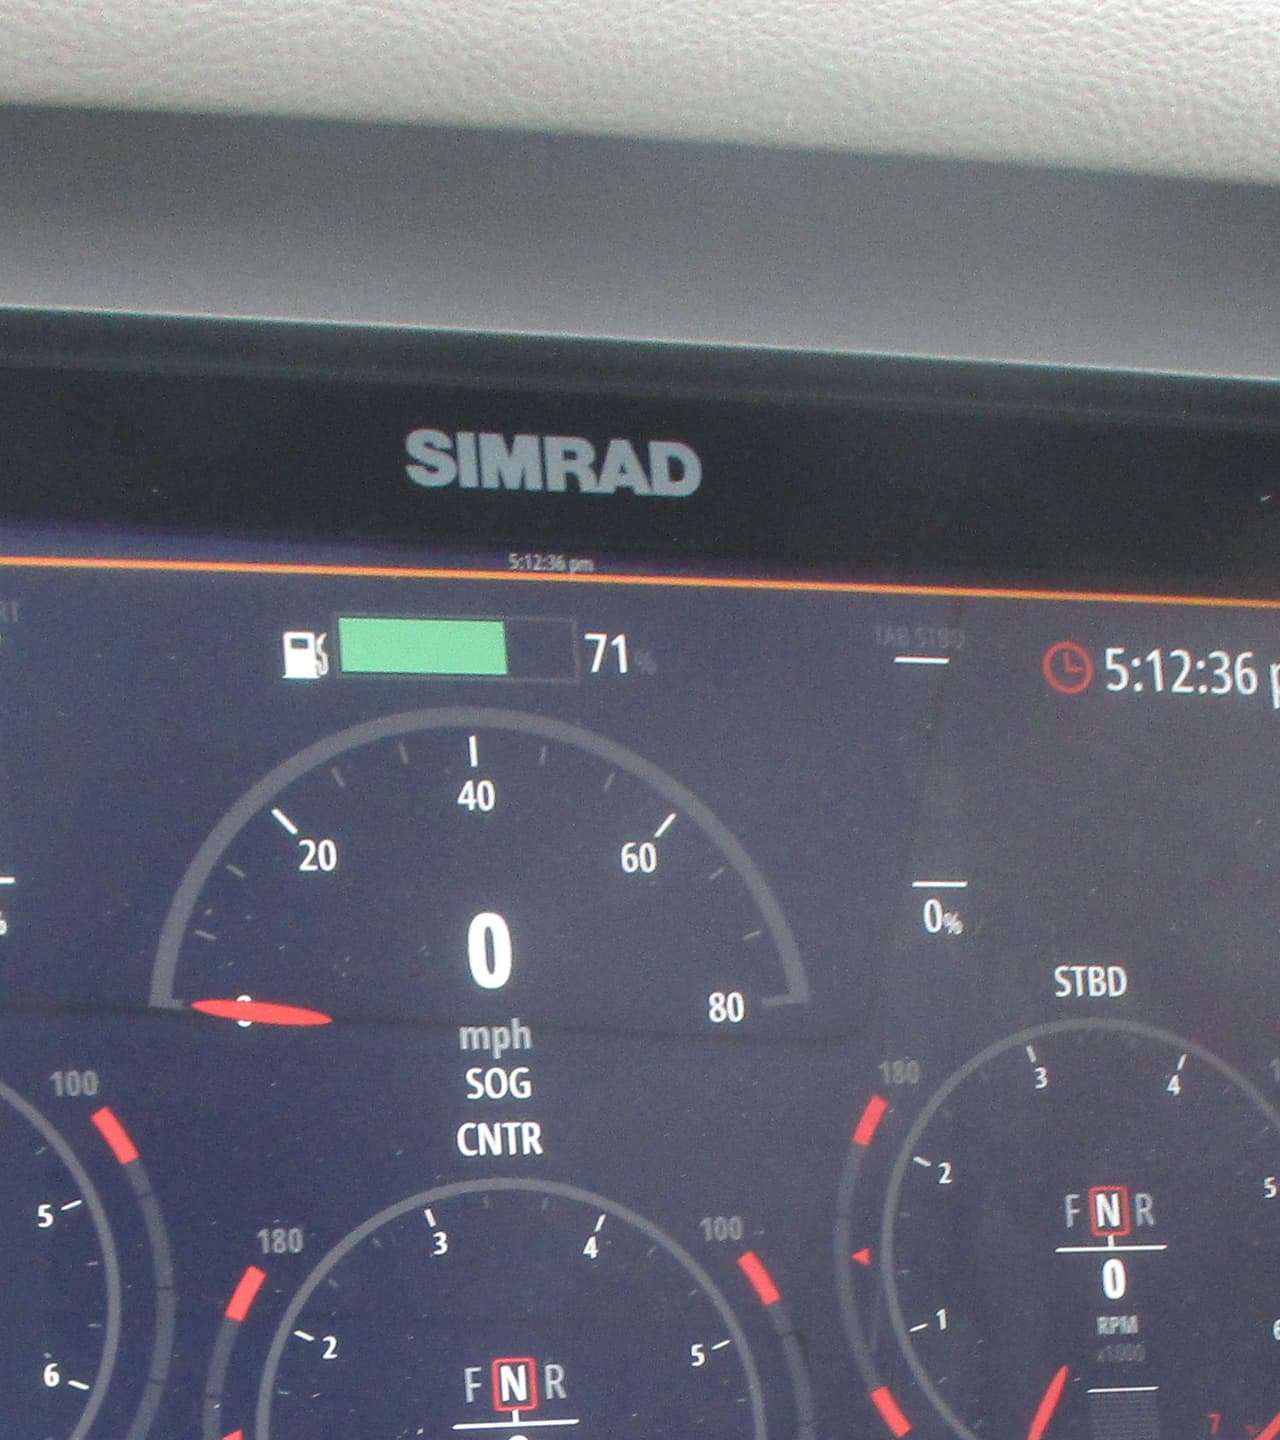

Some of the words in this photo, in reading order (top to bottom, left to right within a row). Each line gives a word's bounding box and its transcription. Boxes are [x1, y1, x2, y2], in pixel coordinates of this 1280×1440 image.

[405, 429, 701, 496] SIMRAD
[583, 632, 628, 674] 71
[1104, 646, 1258, 696] 5:12:36
[457, 780, 495, 812] 40
[298, 839, 337, 872] 20
[620, 841, 657, 873] 60
[467, 911, 513, 989] 0
[1054, 965, 1128, 999] STBD
[708, 992, 745, 1024] 80
[459, 1018, 532, 1059] mph
[49, 1071, 99, 1097] 100
[465, 1067, 532, 1100] SOG
[879, 1061, 920, 1085] 180
[1034, 1067, 1048, 1090] 3
[1166, 1074, 1182, 1096] 4
[457, 1122, 543, 1158] CNTR
[938, 1162, 953, 1185] 2
[1263, 1177, 1277, 1199] 5
[37, 1204, 54, 1228] 5
[1064, 1194, 1080, 1228] F
[1095, 1192, 1121, 1227] N
[1134, 1193, 1155, 1226] R
[257, 1228, 303, 1255] 180
[699, 1217, 743, 1242] 100
[432, 1231, 449, 1256] 3
[582, 1236, 599, 1261] 4
[1102, 1258, 1126, 1300] 0
[936, 1309, 948, 1330] 1
[1096, 1315, 1139, 1335] RPM
[322, 1335, 339, 1360] 2
[689, 1343, 706, 1368] 5
[43, 1362, 60, 1387] 6
[464, 1366, 483, 1402] F
[499, 1363, 528, 1402] N
[545, 1363, 567, 1399] R
